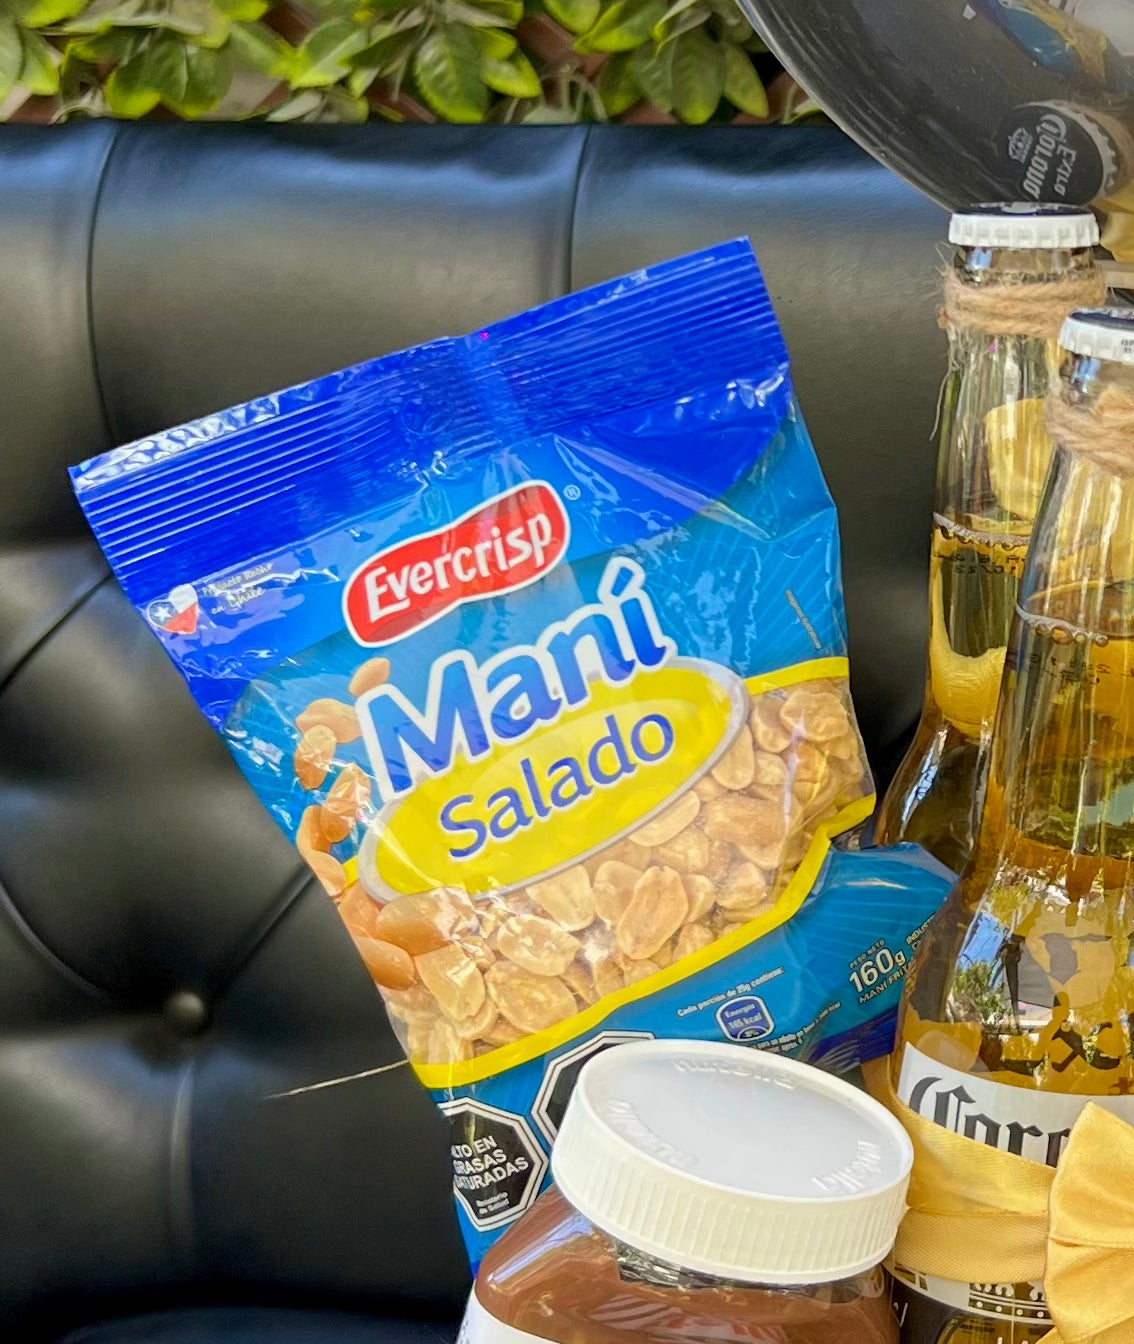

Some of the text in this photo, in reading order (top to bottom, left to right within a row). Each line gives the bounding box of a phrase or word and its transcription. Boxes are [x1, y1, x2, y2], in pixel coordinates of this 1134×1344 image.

[364, 515, 554, 622] Evercrisp
[362, 558, 672, 796] Maní
[439, 711, 675, 860] Salado
[849, 948, 906, 993] 160g
[474, 1135, 498, 1154] EN
